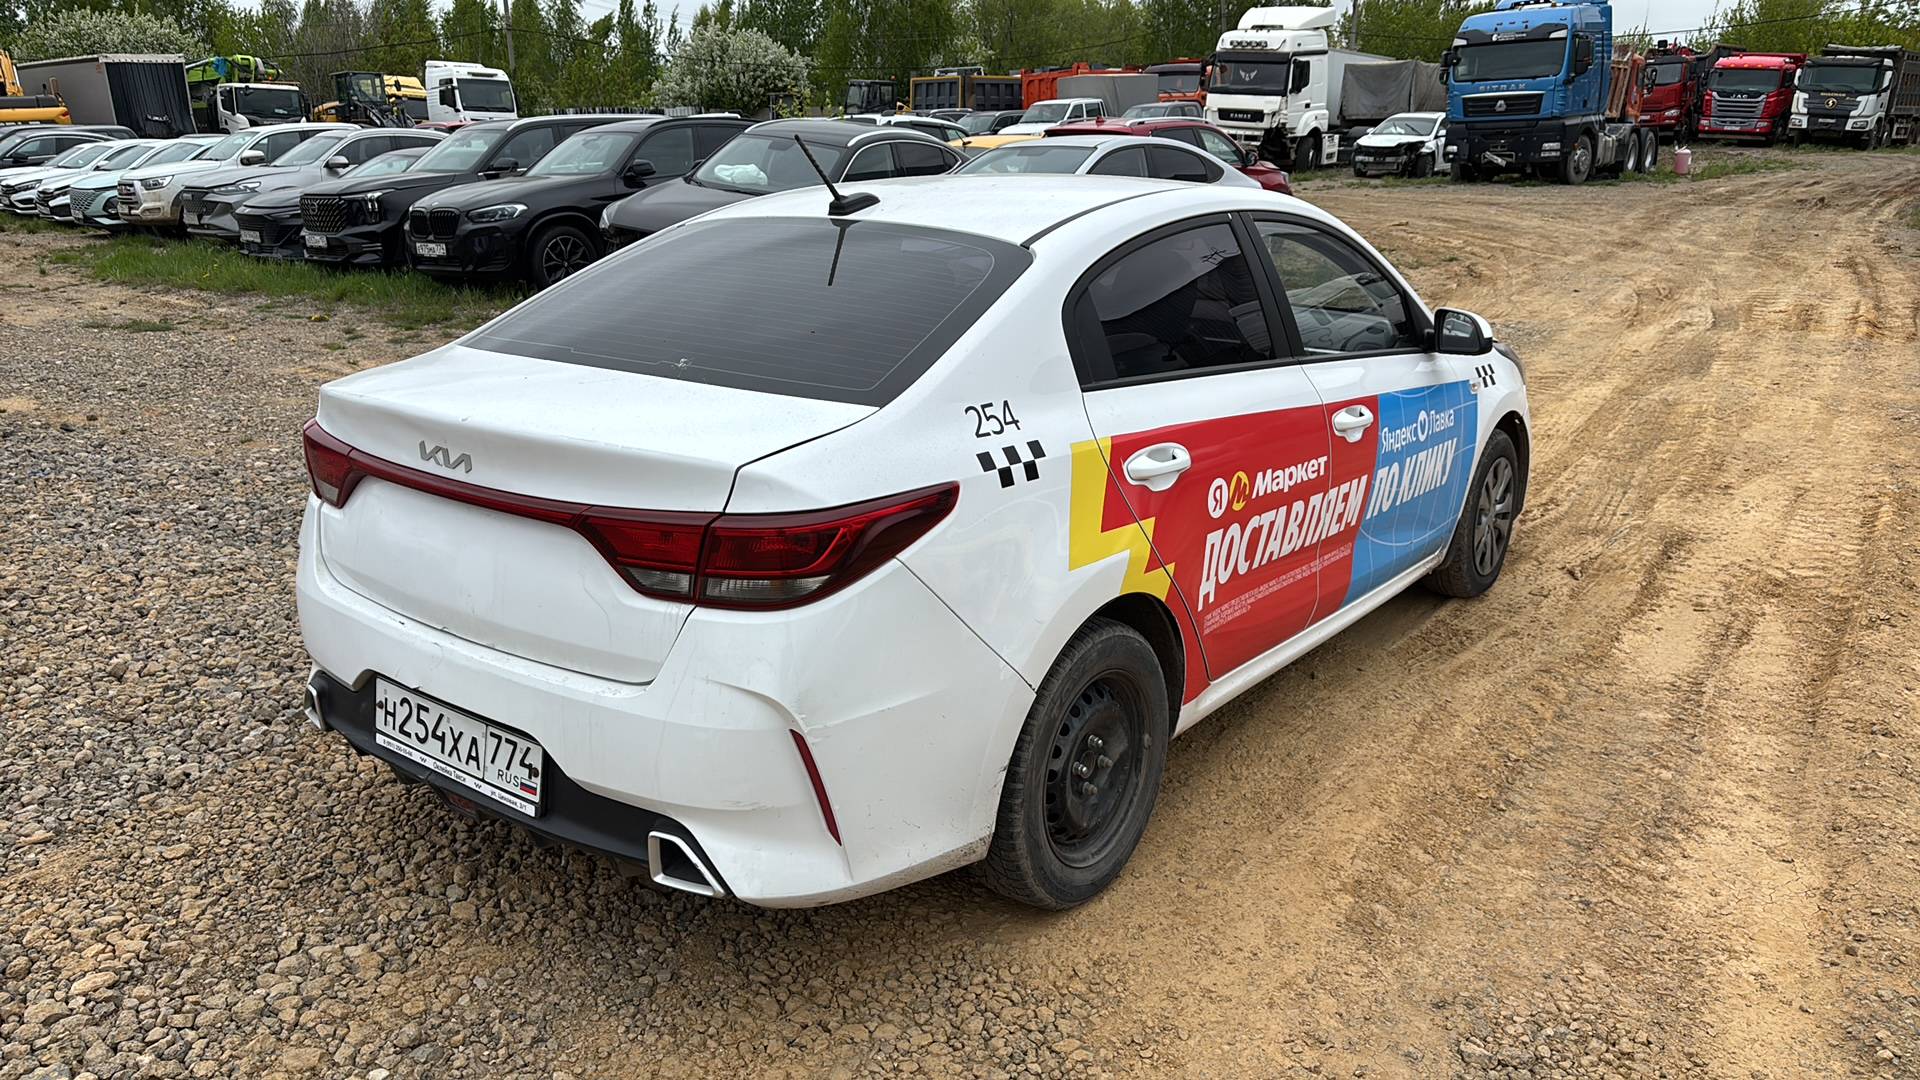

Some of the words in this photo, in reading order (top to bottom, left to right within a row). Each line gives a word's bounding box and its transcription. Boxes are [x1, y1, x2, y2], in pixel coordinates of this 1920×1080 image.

[964, 400, 1021, 438] 254
[1381, 426, 1417, 454] Яндекс
[1429, 409, 1455, 435] Лавка
[1251, 455, 1328, 499] Маркет
[1198, 475, 1368, 612] ДОСТАВЛЯЕМ
[1366, 462, 1402, 521] ПО
[1398, 437, 1458, 501] КЛИКУ
[383, 696, 481, 771] Н254ХА
[489, 732, 535, 781] 774
[497, 770, 520, 788] RUS
